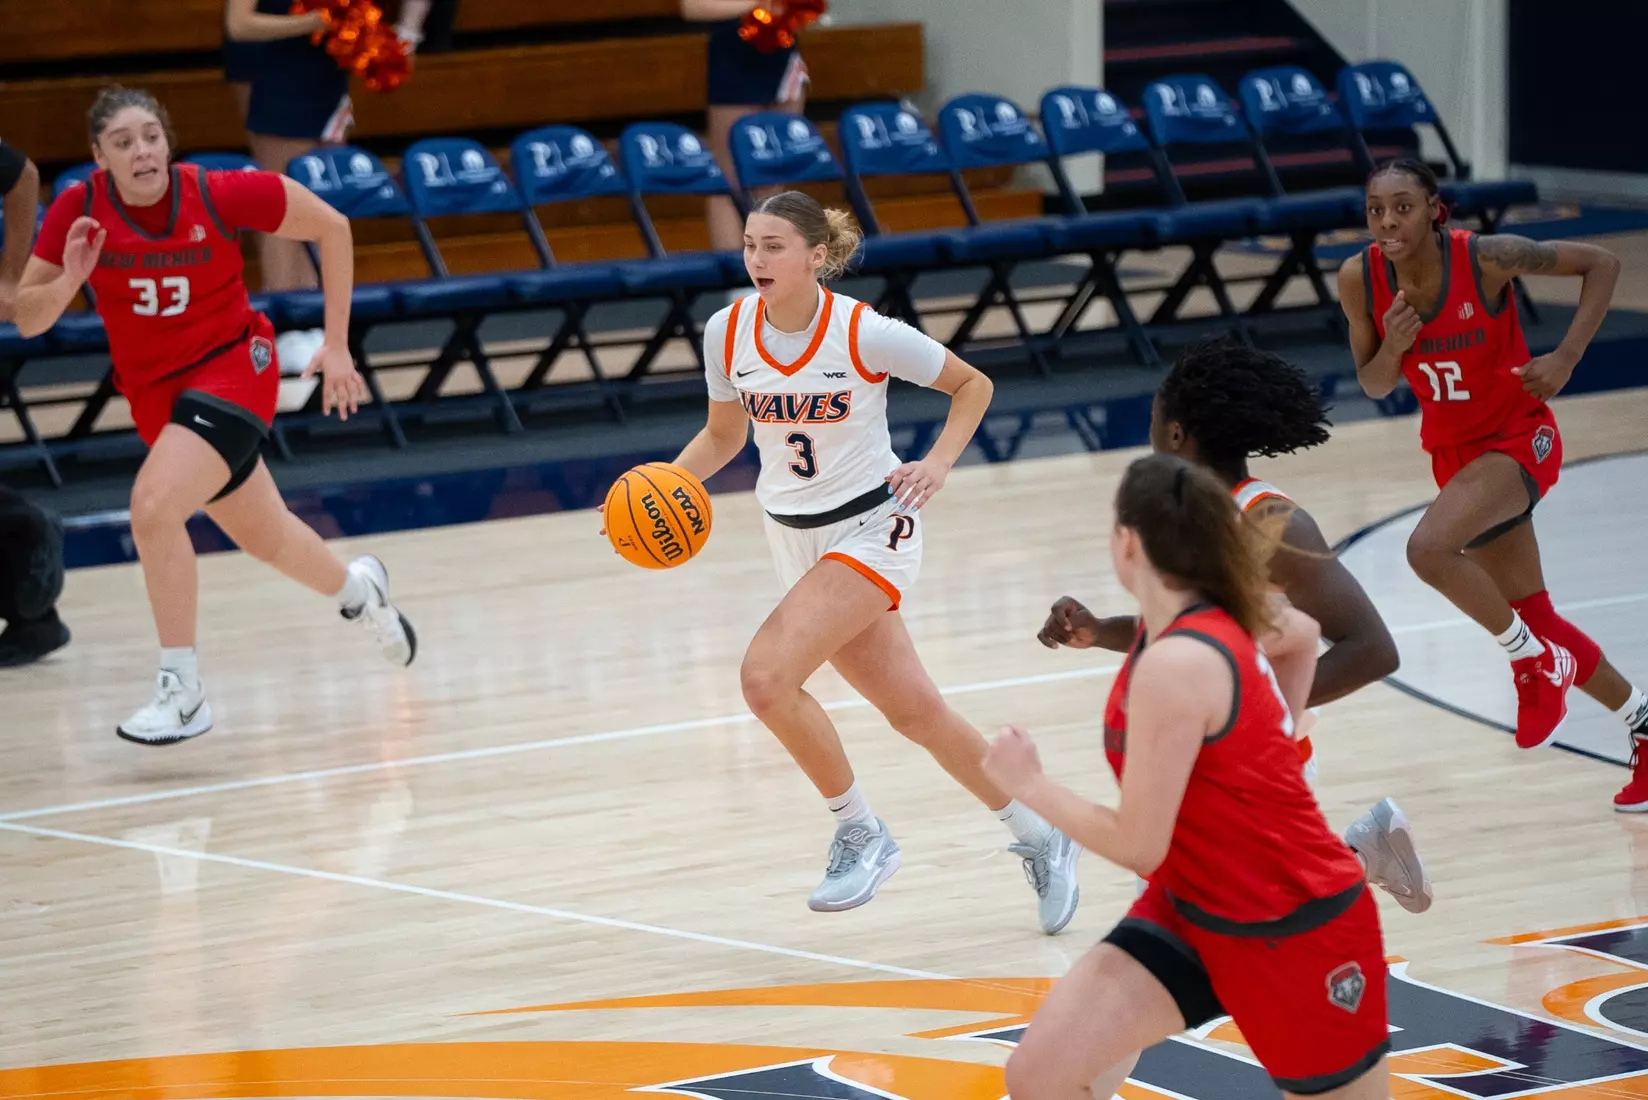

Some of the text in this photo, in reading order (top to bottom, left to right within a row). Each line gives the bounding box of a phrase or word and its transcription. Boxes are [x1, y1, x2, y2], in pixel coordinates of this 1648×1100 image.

[142, 247, 211, 269] MEXICO
[128, 276, 190, 316] 33
[1422, 328, 1486, 353] MEXICO
[1418, 360, 1471, 402] 12
[738, 389, 852, 424] WAVES
[784, 430, 819, 481] 3
[641, 492, 684, 562] Wilson
[671, 486, 705, 536] NCAA
[884, 513, 915, 551] P
